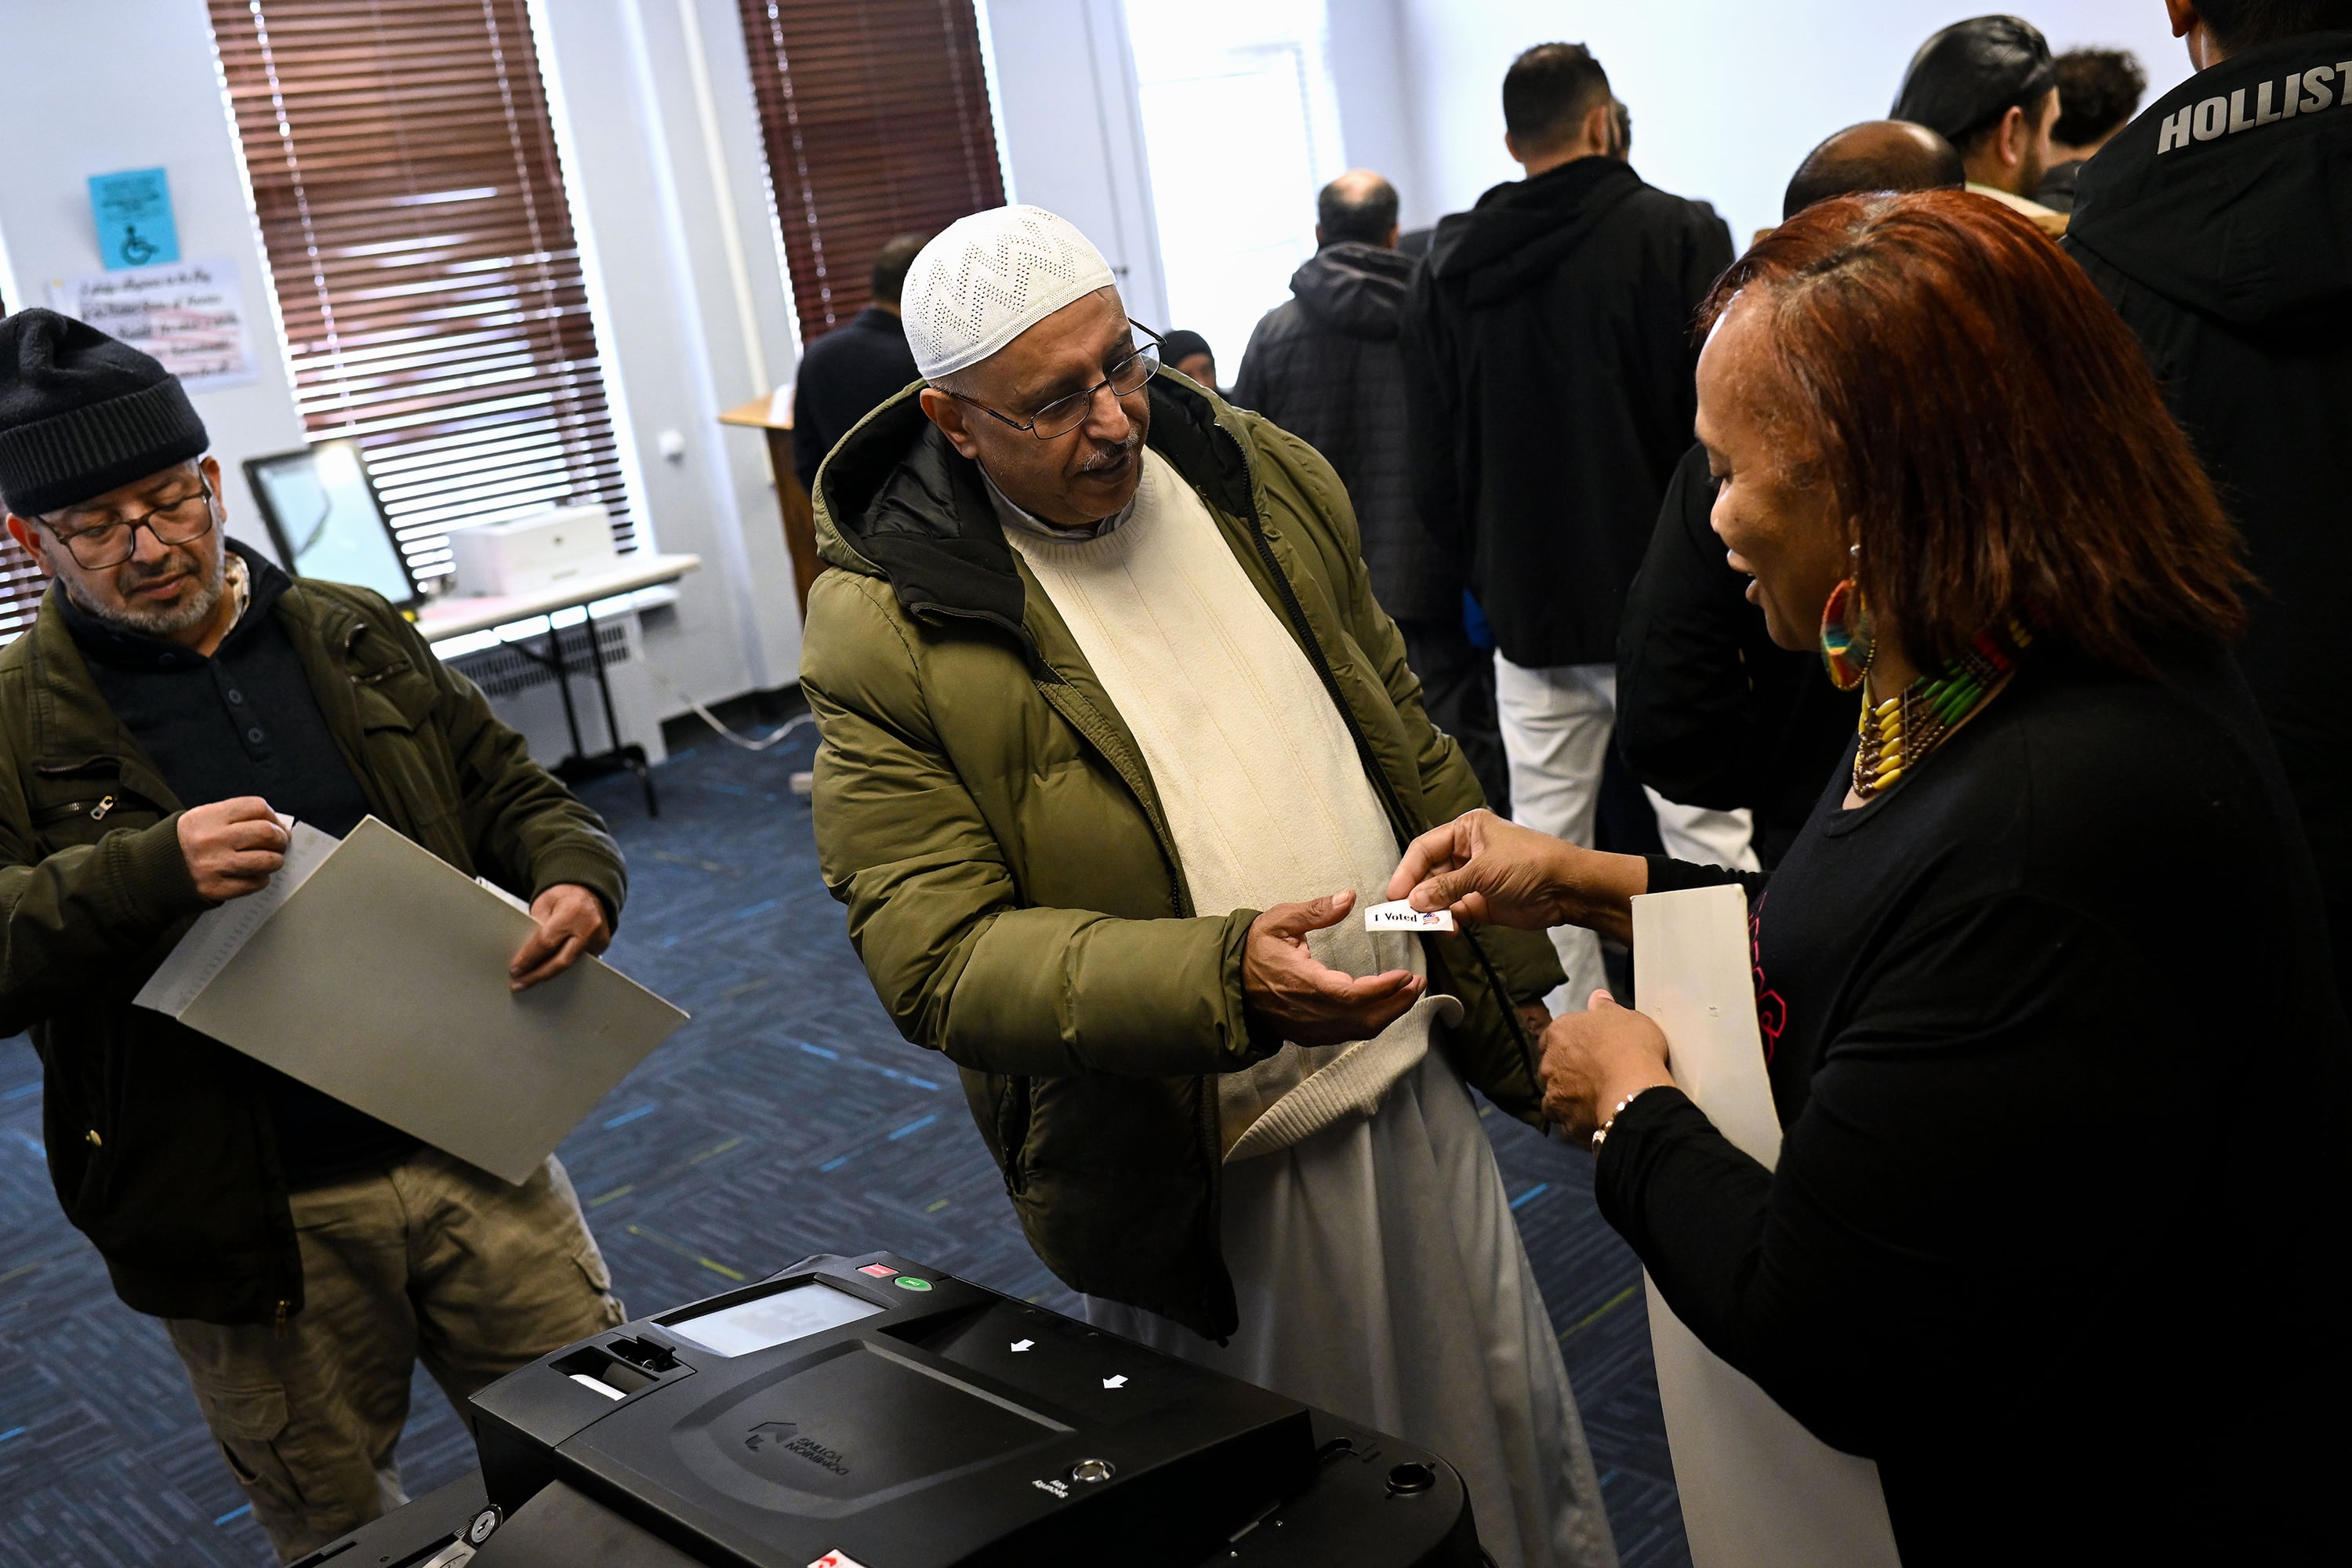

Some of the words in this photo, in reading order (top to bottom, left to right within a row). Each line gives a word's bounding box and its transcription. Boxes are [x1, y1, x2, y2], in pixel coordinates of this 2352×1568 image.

[1385, 913, 1417, 922] Voted
[784, 1442, 850, 1475] DOMINION
[797, 1437, 844, 1462] VOTING
